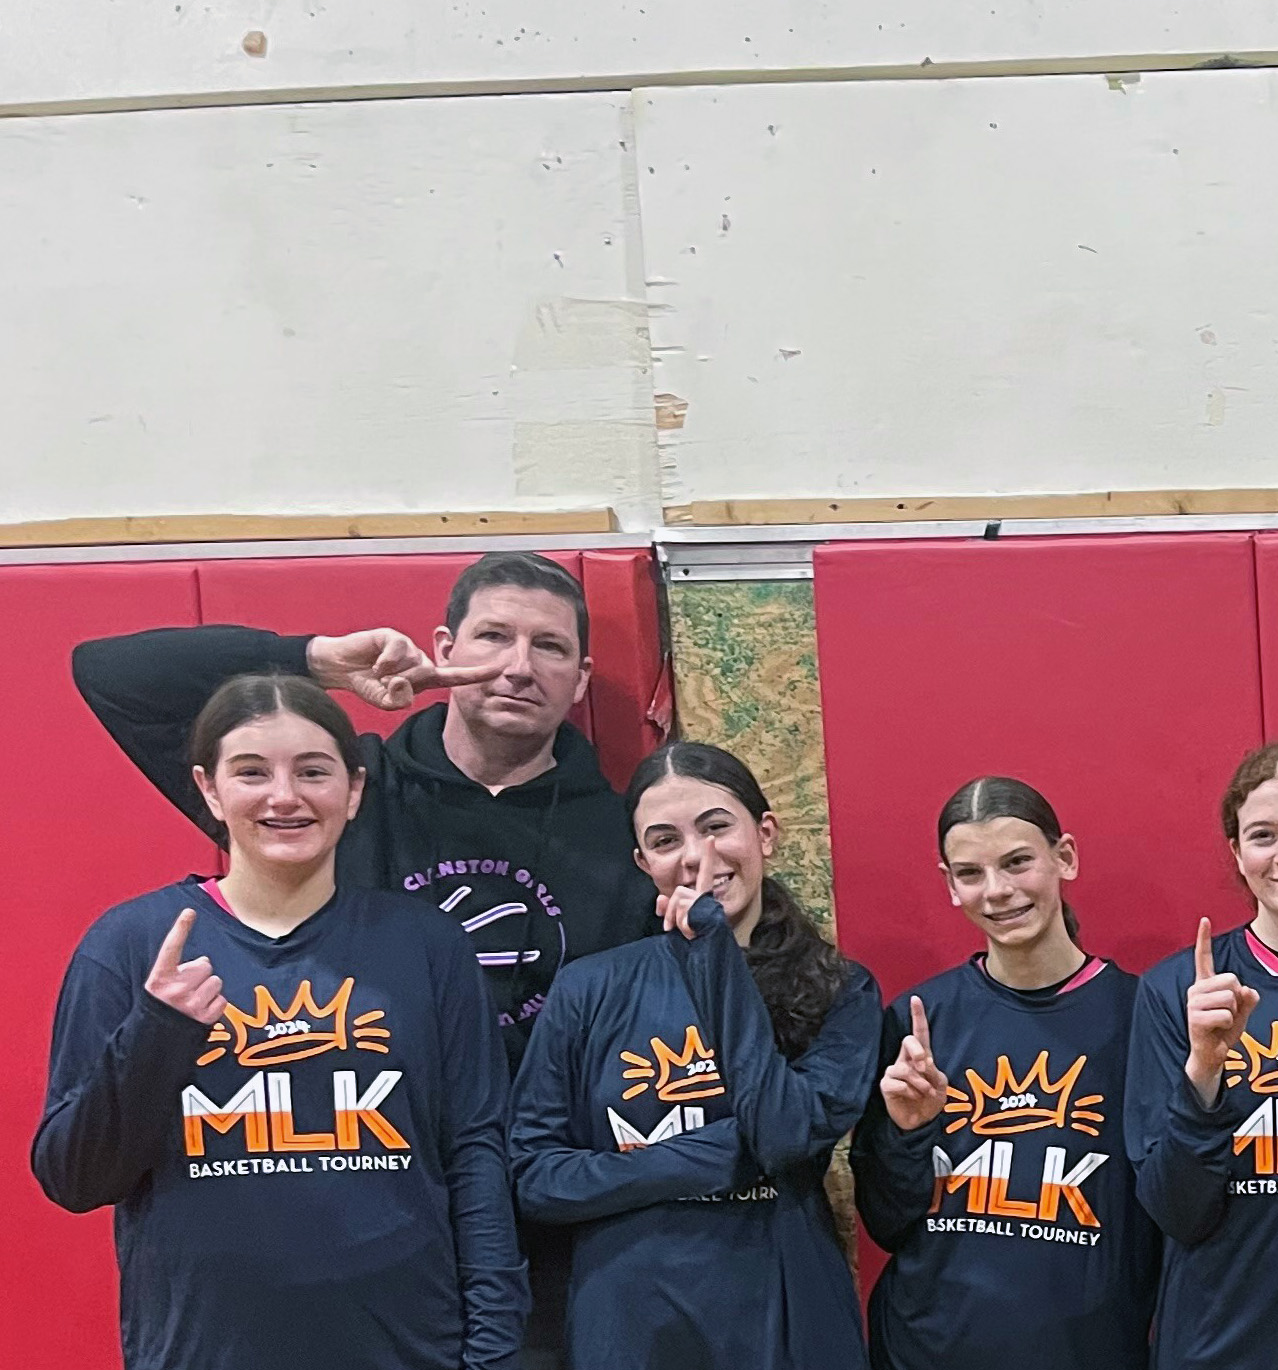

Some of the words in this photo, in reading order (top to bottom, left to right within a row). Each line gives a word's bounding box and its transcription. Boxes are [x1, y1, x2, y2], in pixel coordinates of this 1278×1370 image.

[264, 1019, 311, 1038] 2024
[686, 1059, 717, 1076] 202
[998, 1092, 1038, 1110] 2024
[182, 1070, 411, 1157] MLK
[189, 1156, 313, 1179] BASKETBALL
[318, 1155, 412, 1172] TOURNEY
[927, 1138, 1110, 1228] MLK
[1020, 1223, 1101, 1247] TOURNEY
